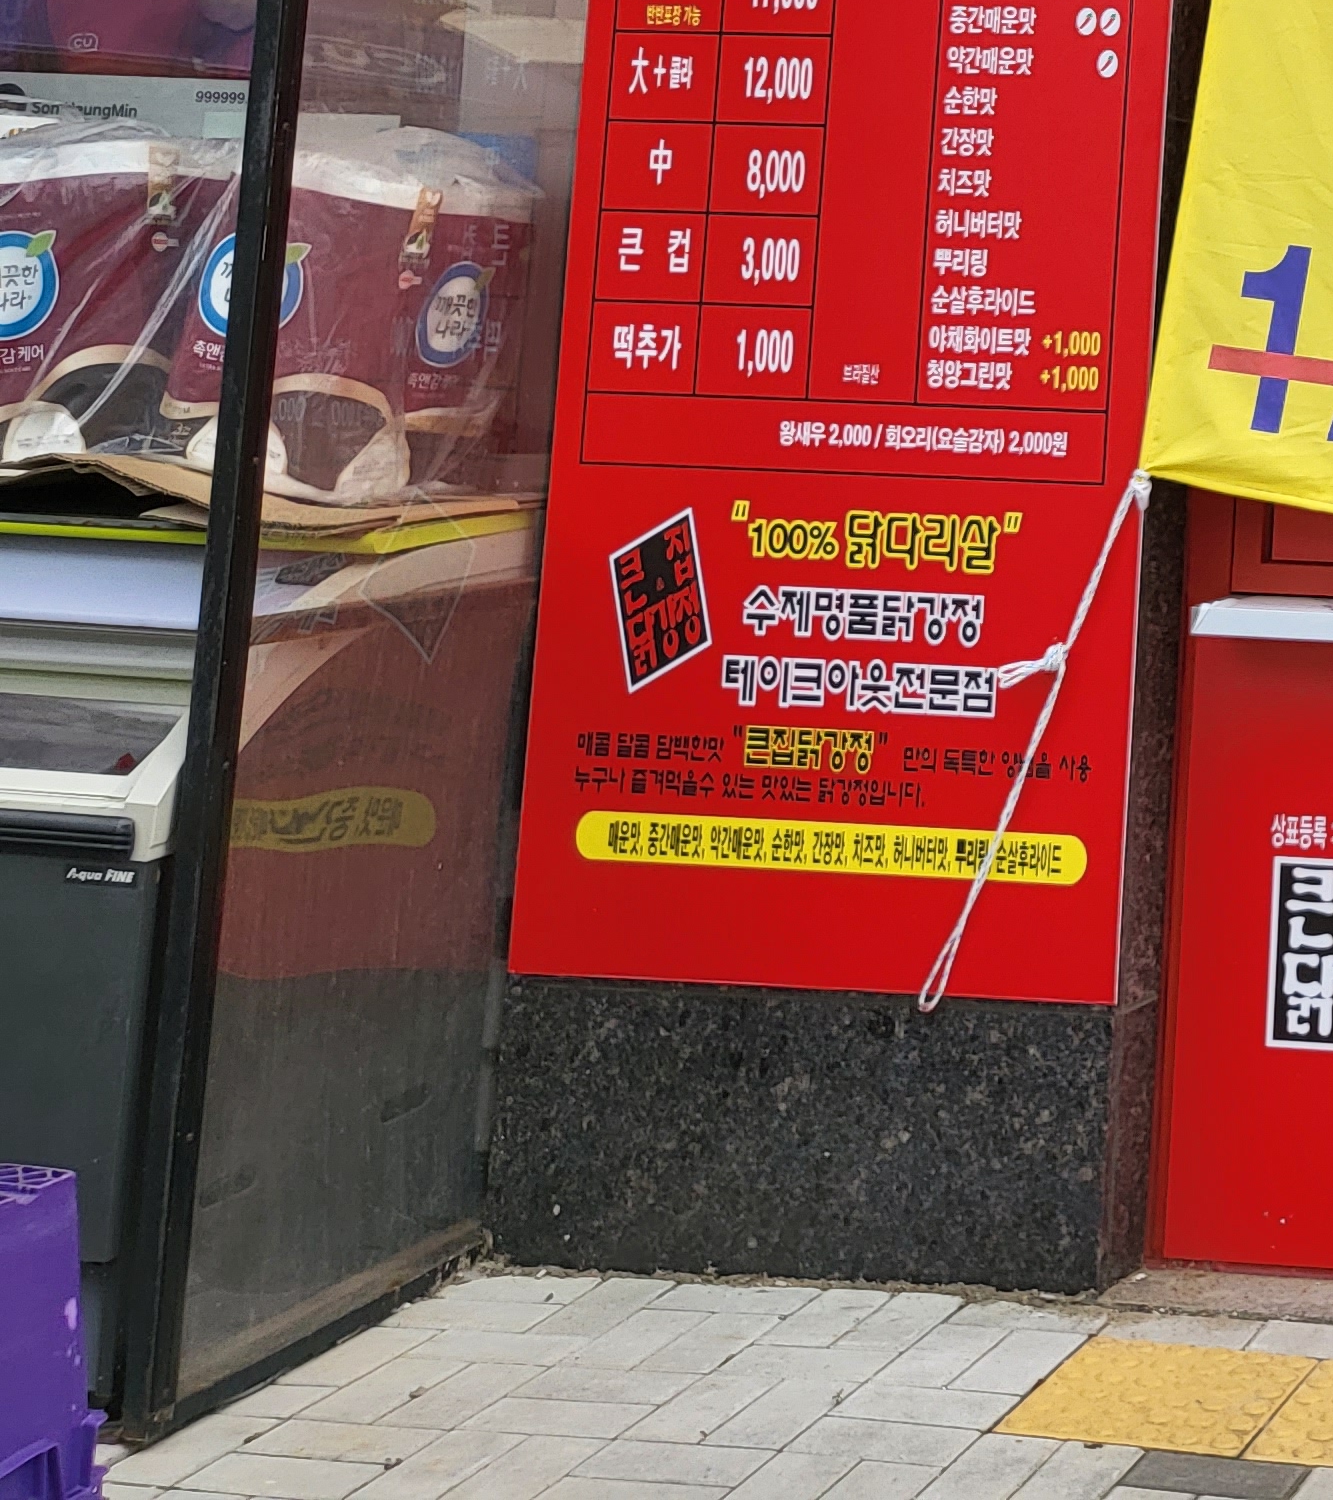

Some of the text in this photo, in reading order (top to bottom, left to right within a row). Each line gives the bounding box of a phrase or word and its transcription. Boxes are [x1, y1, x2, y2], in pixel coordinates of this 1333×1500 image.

[949, 6, 1036, 35] 중간매운맛
[745, 46, 1034, 104] 12,000 약간매운맛
[944, 86, 997, 116] 순한맛
[649, 127, 994, 199] 中 8,000 간장맛
[937, 169, 991, 197] 치즈맛
[618, 209, 1022, 285] 큰 컵 3,000 허니버터맛
[933, 248, 988, 277] 뿌리링
[931, 286, 1036, 316] 순살후라이드
[613, 324, 793, 377] 떡추가 1,000
[928, 327, 1101, 358] 야채화이트맛 +1,000
[926, 360, 1012, 390] 청양그린맛
[1039, 367, 1099, 393] +1,000
[779, 420, 826, 447] 왕새우
[829, 423, 872, 447] 2,000
[1009, 431, 1068, 458] 2,000원
[743, 585, 985, 648] 수제명품닭강정
[722, 655, 998, 717] 테이크아웃전문점
[575, 766, 625, 793] 누구나
[722, 773, 755, 799] 있는
[762, 775, 811, 802] 맛있는
[1060, 754, 1092, 783] 사용
